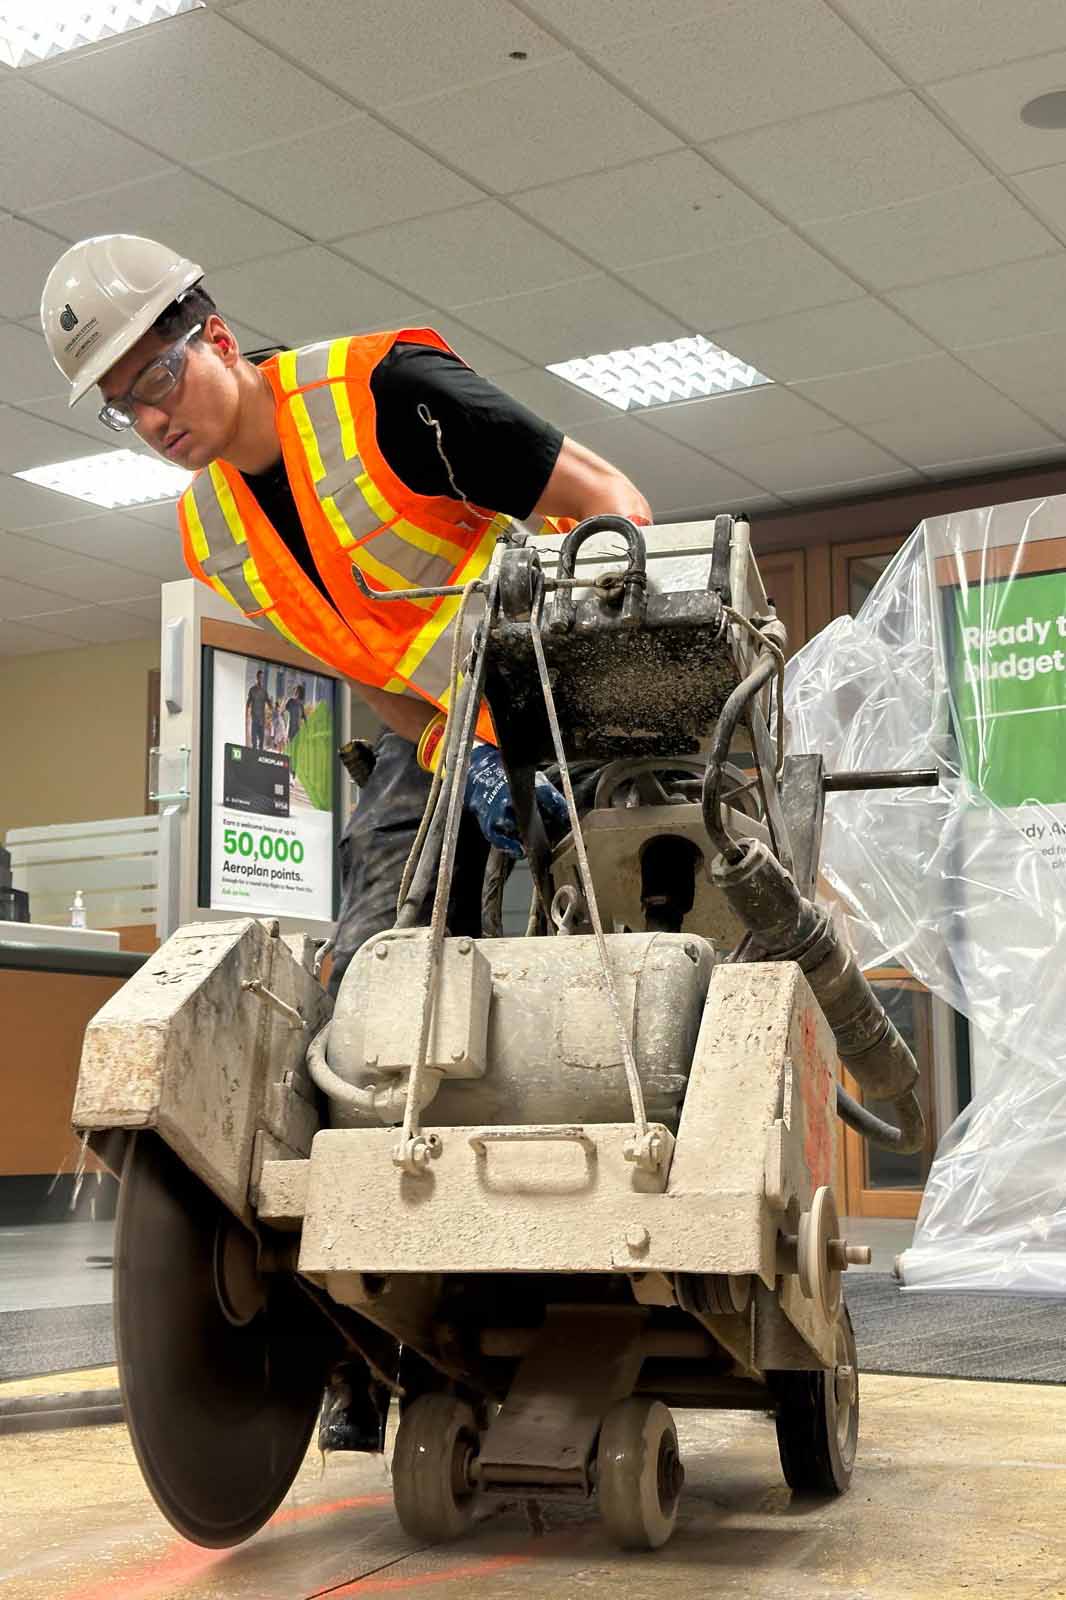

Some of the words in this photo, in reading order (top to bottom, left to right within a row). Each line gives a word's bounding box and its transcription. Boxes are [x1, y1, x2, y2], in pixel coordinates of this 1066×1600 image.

[963, 617, 1051, 651] Ready
[964, 650, 1065, 681] budget
[223, 829, 304, 864] 50,000
[223, 860, 269, 878] Aeroplan
[270, 868, 304, 882] points.
